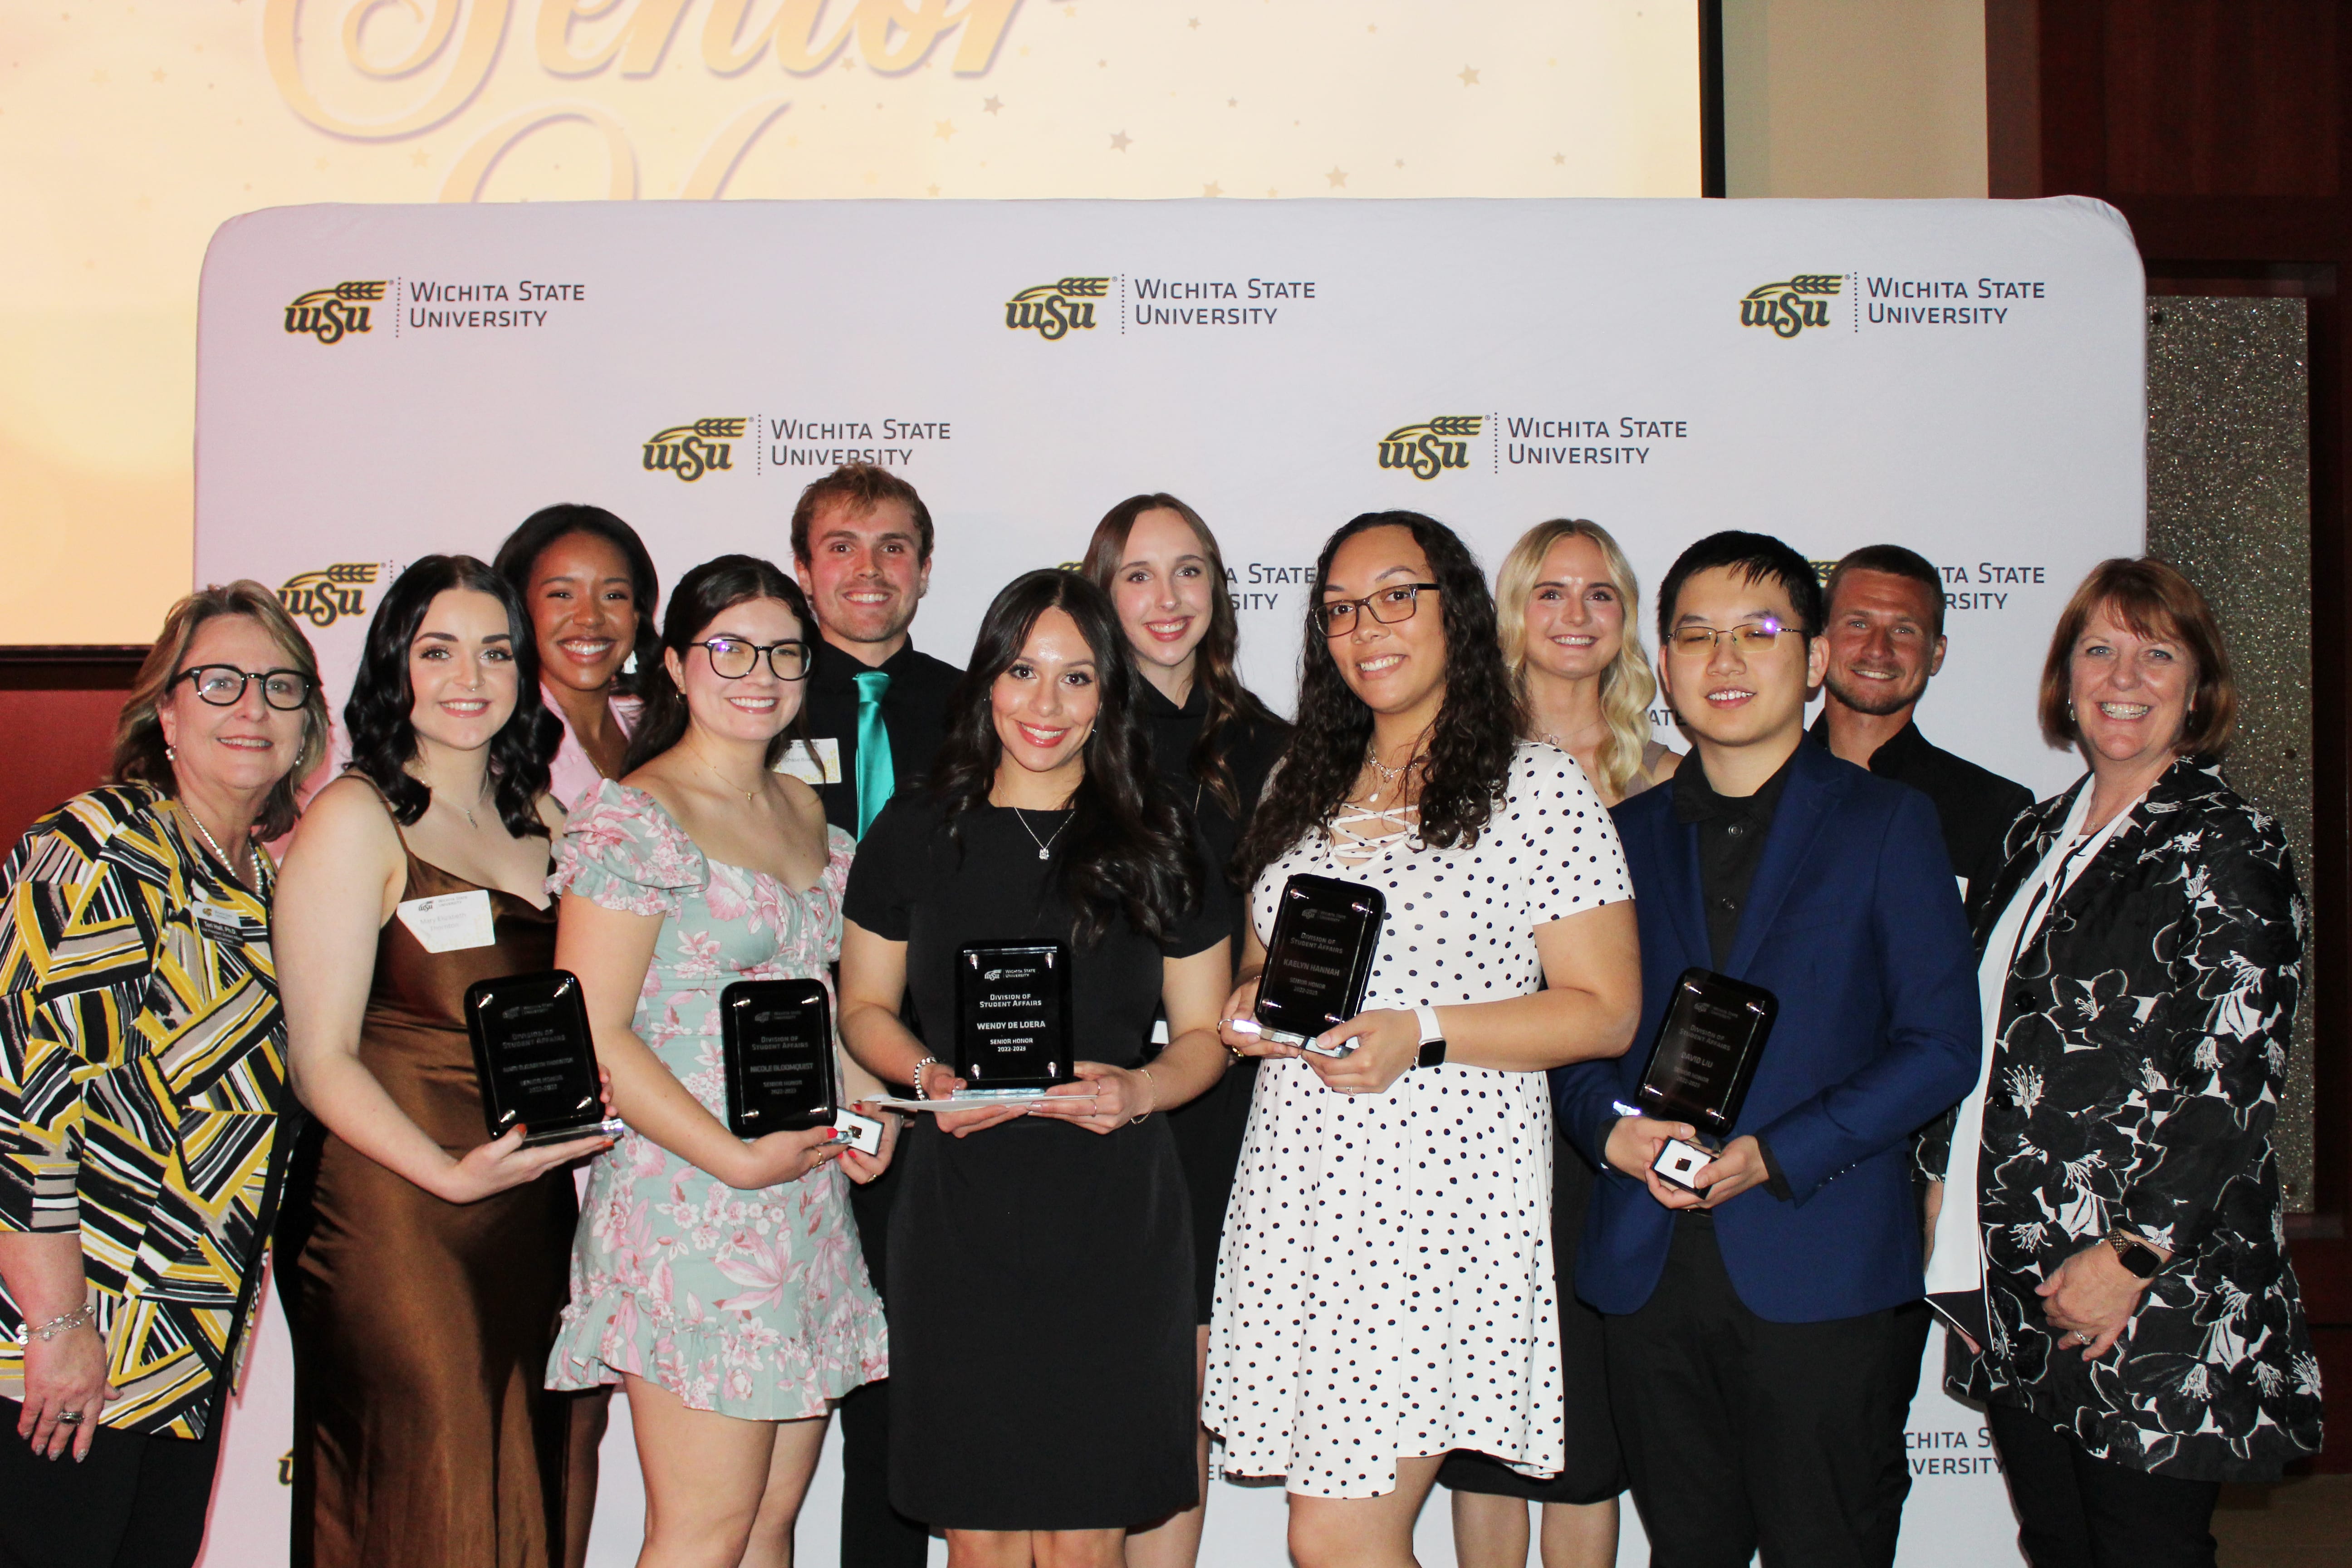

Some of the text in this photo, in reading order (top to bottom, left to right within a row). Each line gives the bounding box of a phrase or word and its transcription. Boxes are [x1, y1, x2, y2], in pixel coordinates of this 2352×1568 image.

[1283, 958, 1340, 976] KAELYN HANNAH
[1681, 1052, 1714, 1068] DAVID LIU
